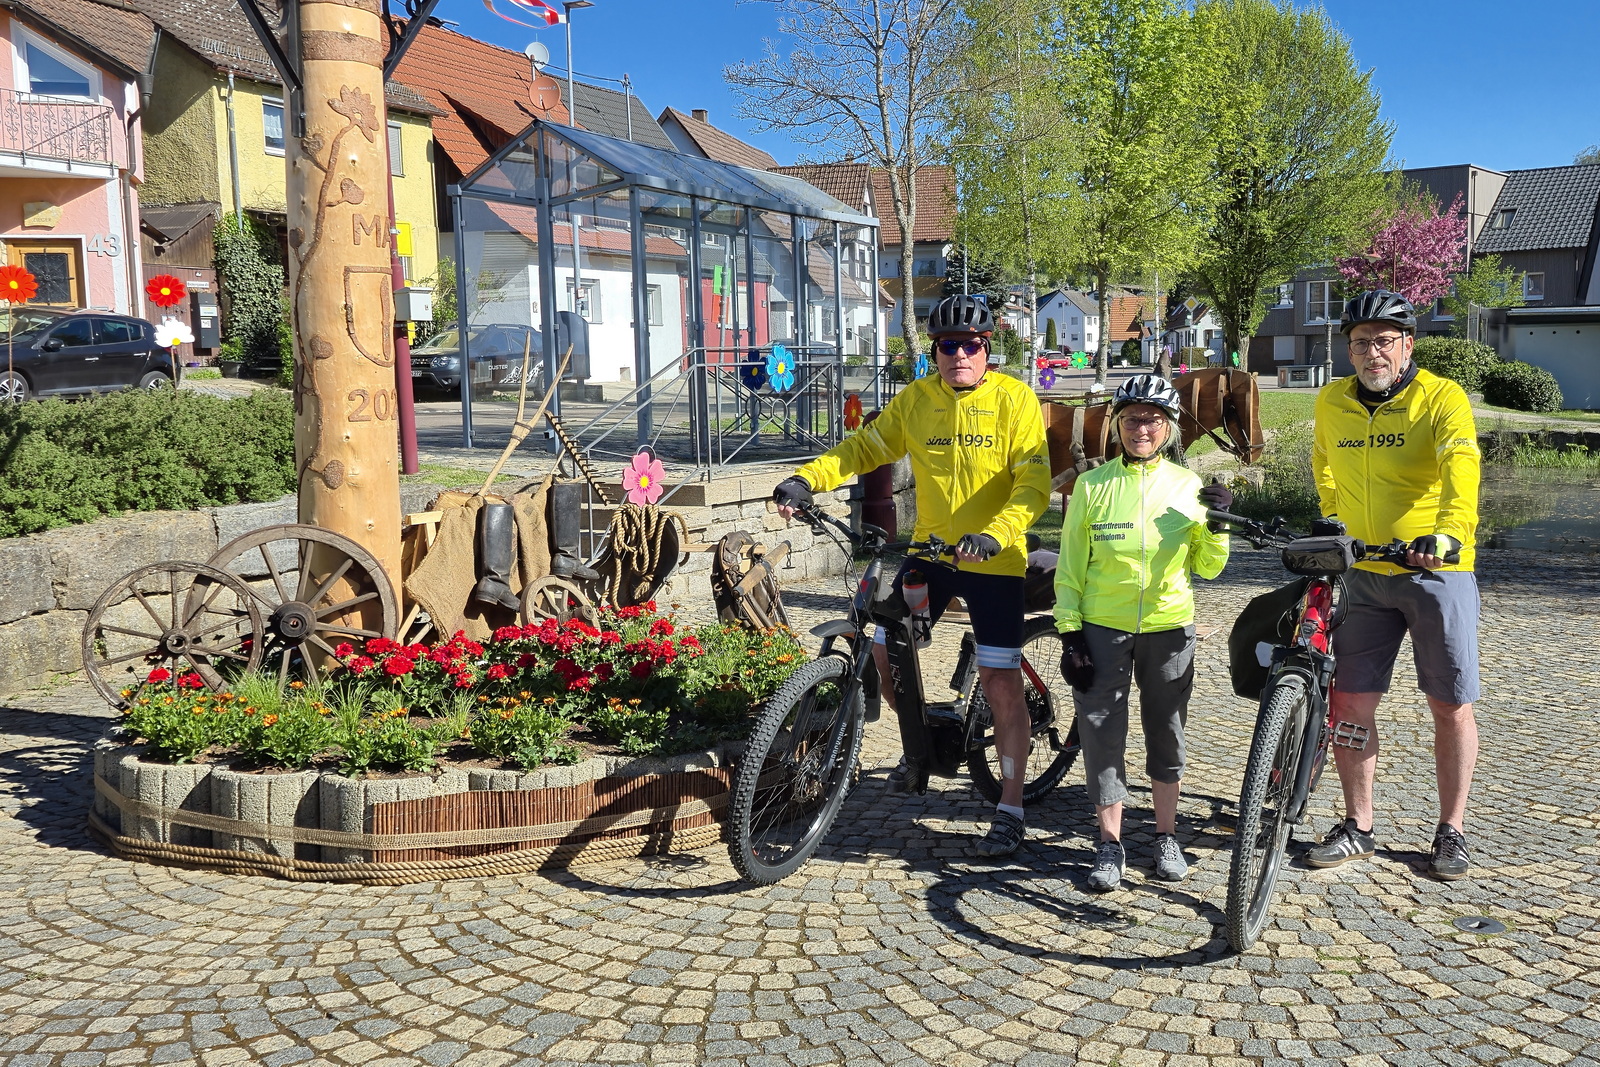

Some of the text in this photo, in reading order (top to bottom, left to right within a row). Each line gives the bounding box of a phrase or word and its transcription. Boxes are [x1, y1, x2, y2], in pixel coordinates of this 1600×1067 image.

[87, 233, 121, 257] 43
[926, 433, 994, 448] since 1995
[1337, 433, 1405, 448] since 1995
[839, 719, 863, 798] SCHWALBE
